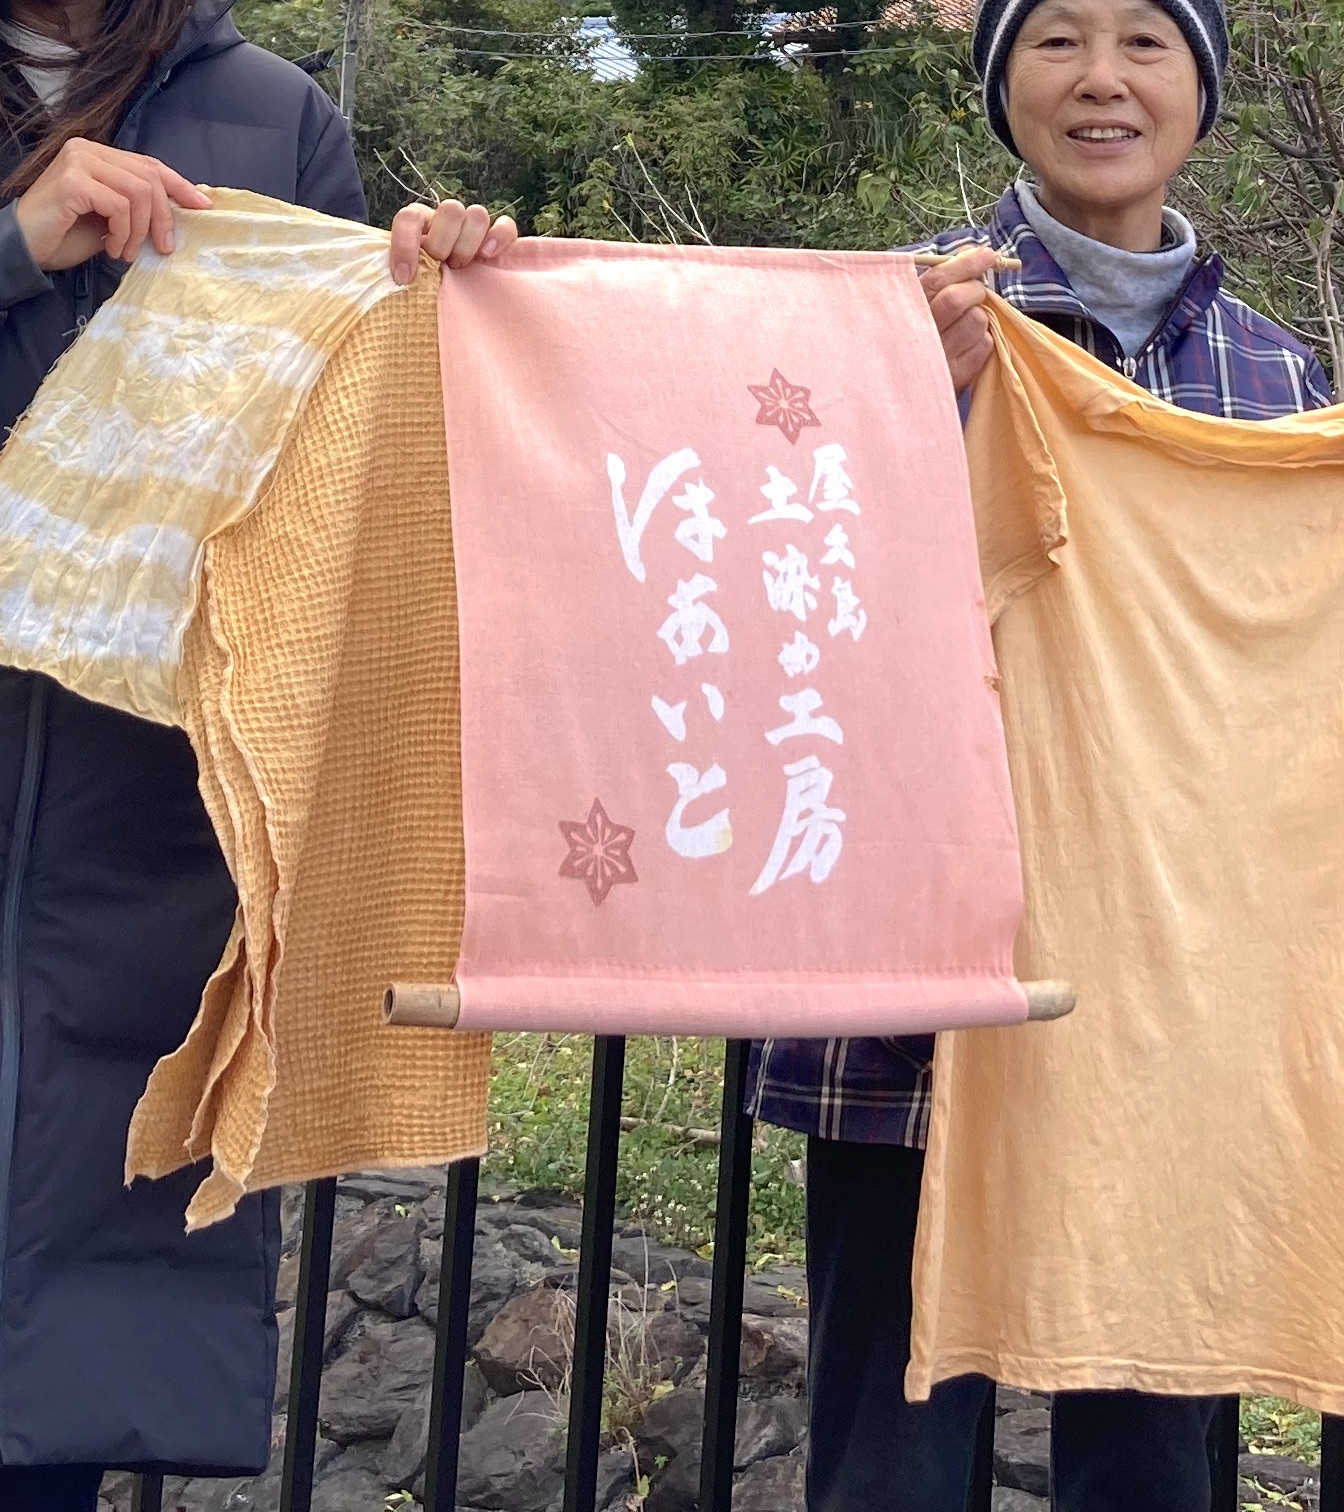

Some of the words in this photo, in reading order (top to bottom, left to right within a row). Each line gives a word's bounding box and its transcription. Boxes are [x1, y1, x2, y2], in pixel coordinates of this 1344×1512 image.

[747, 465, 848, 896] 土染め工房
[808, 442, 868, 643] 屋久島
